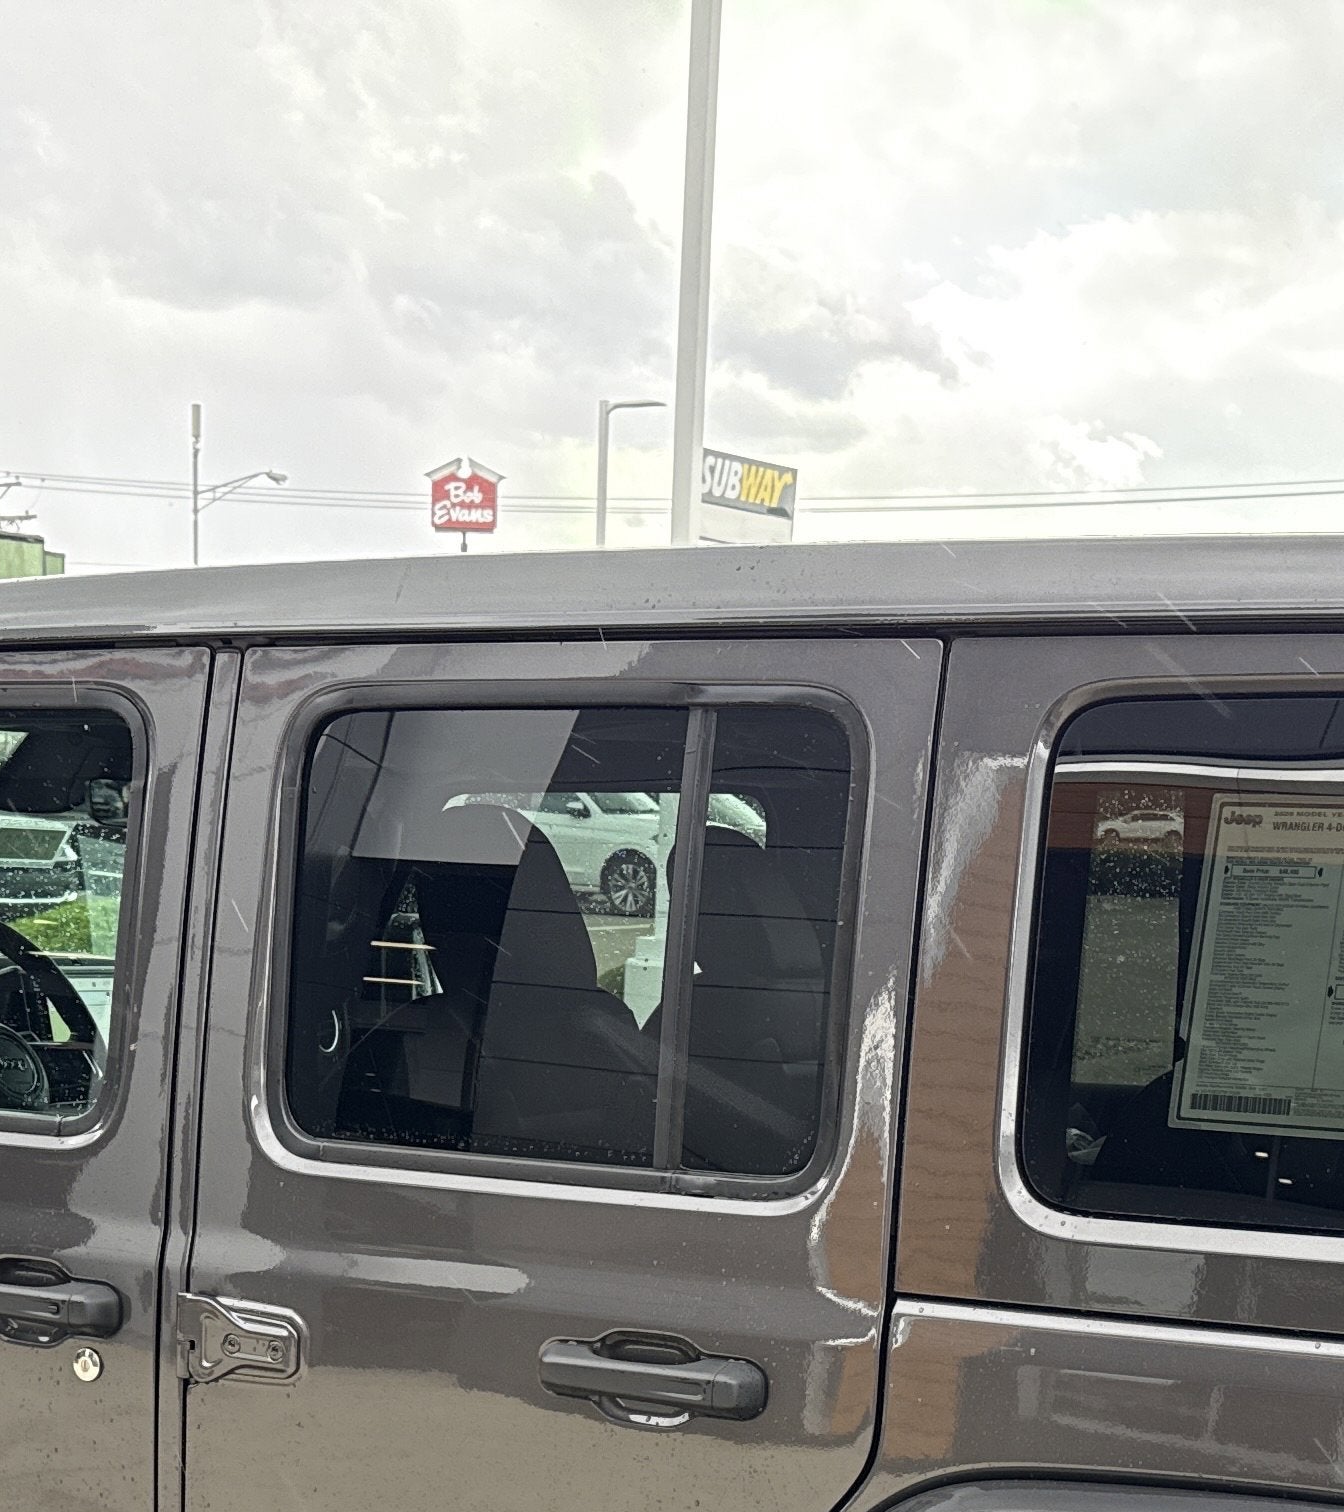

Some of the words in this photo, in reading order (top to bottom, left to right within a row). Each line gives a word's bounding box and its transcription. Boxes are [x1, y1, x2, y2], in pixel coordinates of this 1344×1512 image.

[444, 481, 484, 504] Bob
[701, 455, 794, 508] SUBWAY
[433, 500, 494, 525] Evans
[1223, 810, 1264, 829] Jeep
[1272, 821, 1327, 833] WRANGLER
